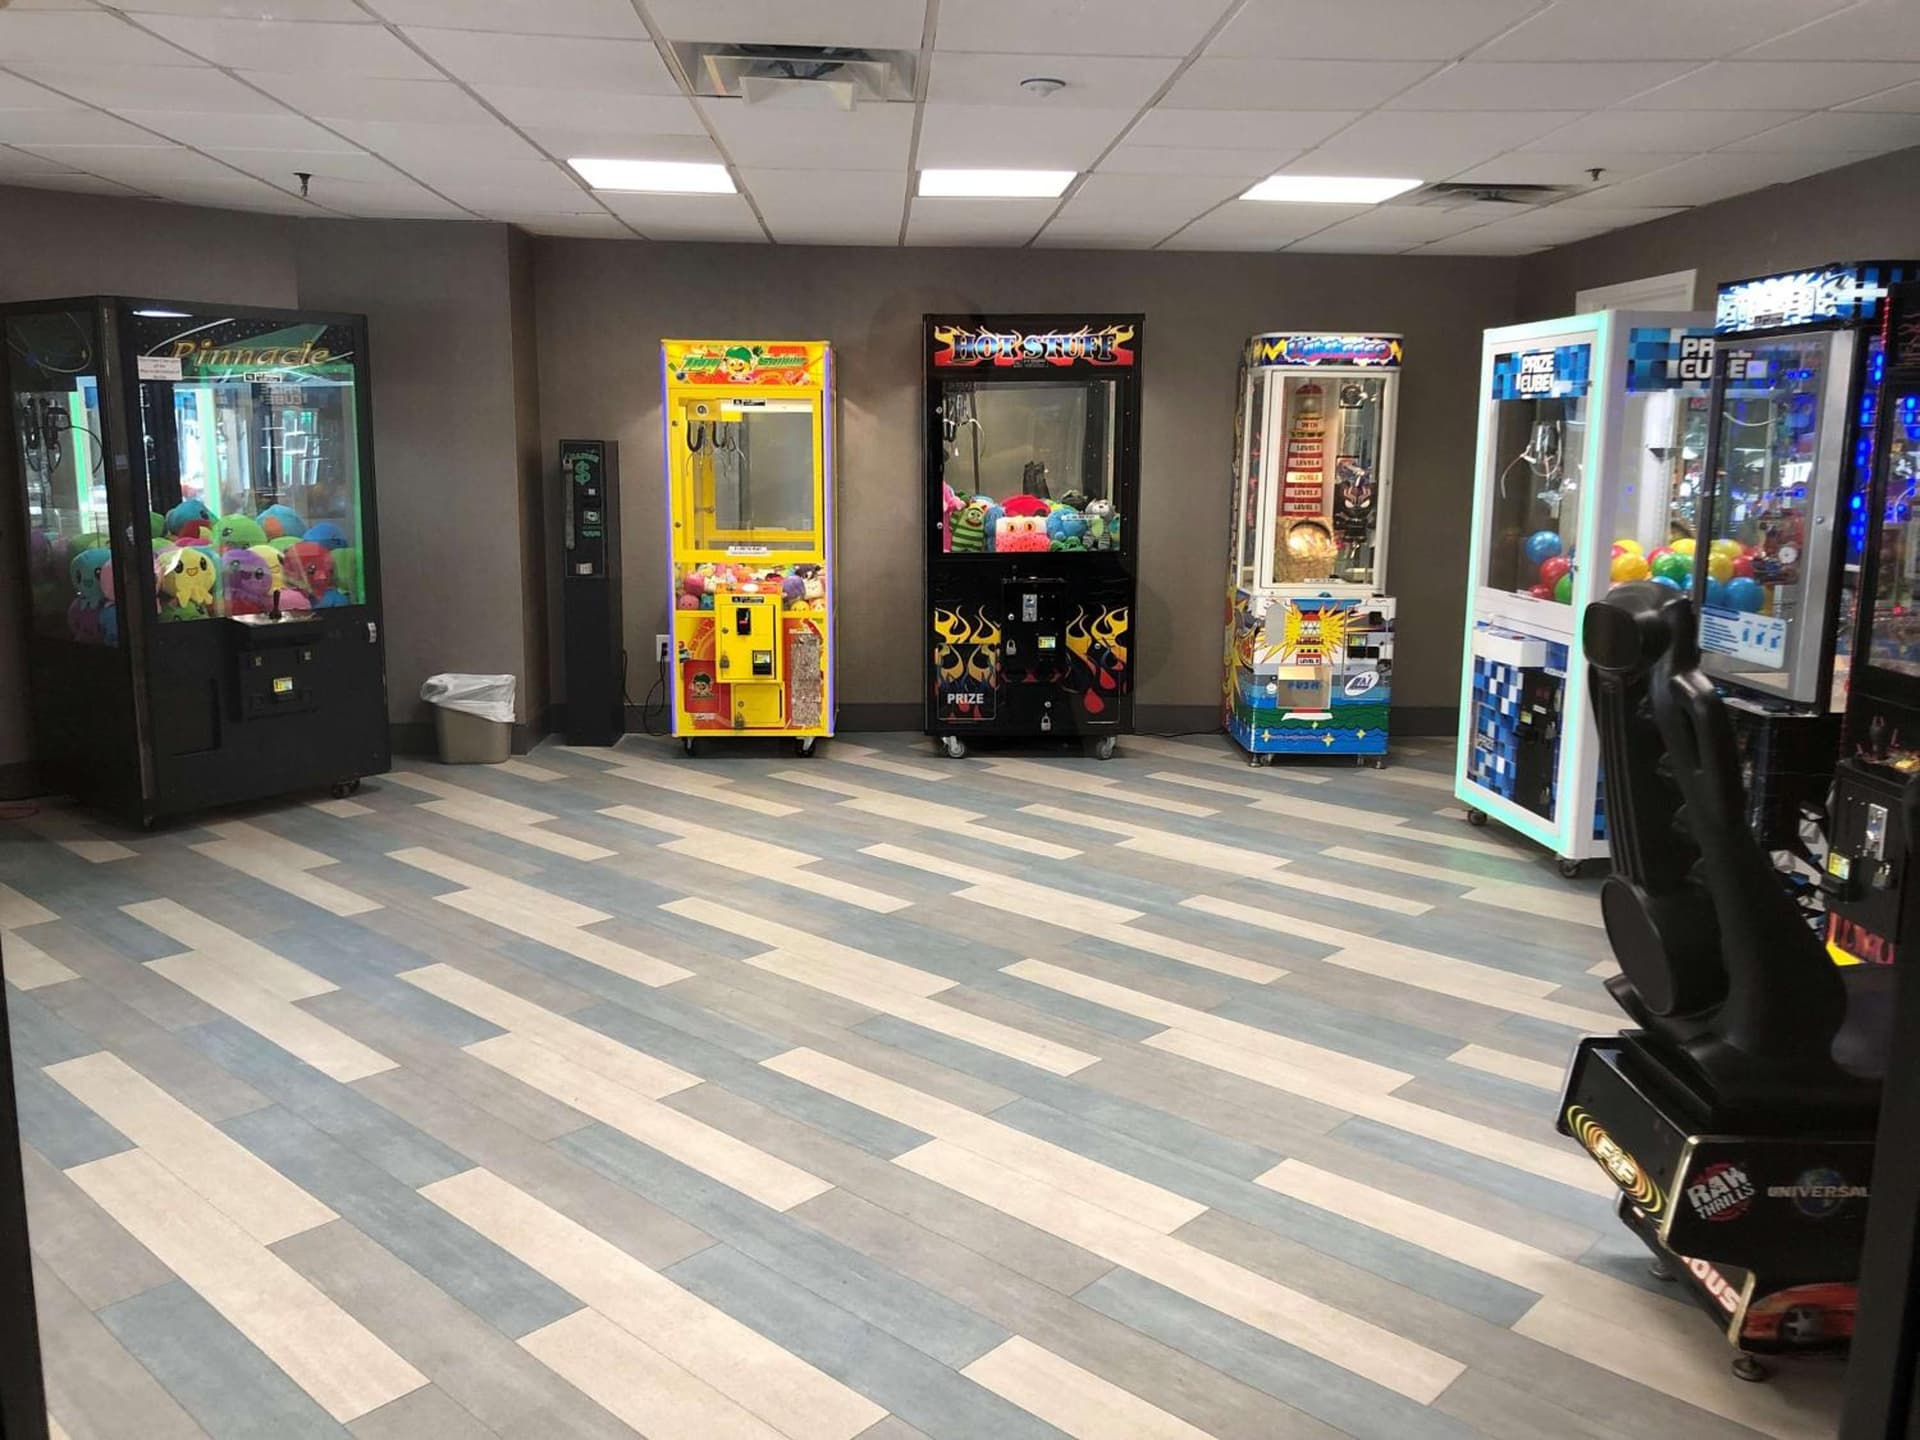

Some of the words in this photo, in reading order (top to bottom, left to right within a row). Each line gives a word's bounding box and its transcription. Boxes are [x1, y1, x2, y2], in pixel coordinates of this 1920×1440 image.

[171, 339, 329, 366] Pinnacle
[952, 334, 1017, 360] HOT
[1023, 334, 1117, 360] STUFF
[1522, 353, 1554, 373] PRIZE
[1679, 358, 1745, 379] CUE
[947, 693, 984, 705] PRIZE
[1687, 1167, 1749, 1209] RAW
[1767, 1186, 1871, 1198] UNIVERSAL
[1695, 1182, 1756, 1220] THRILLS
